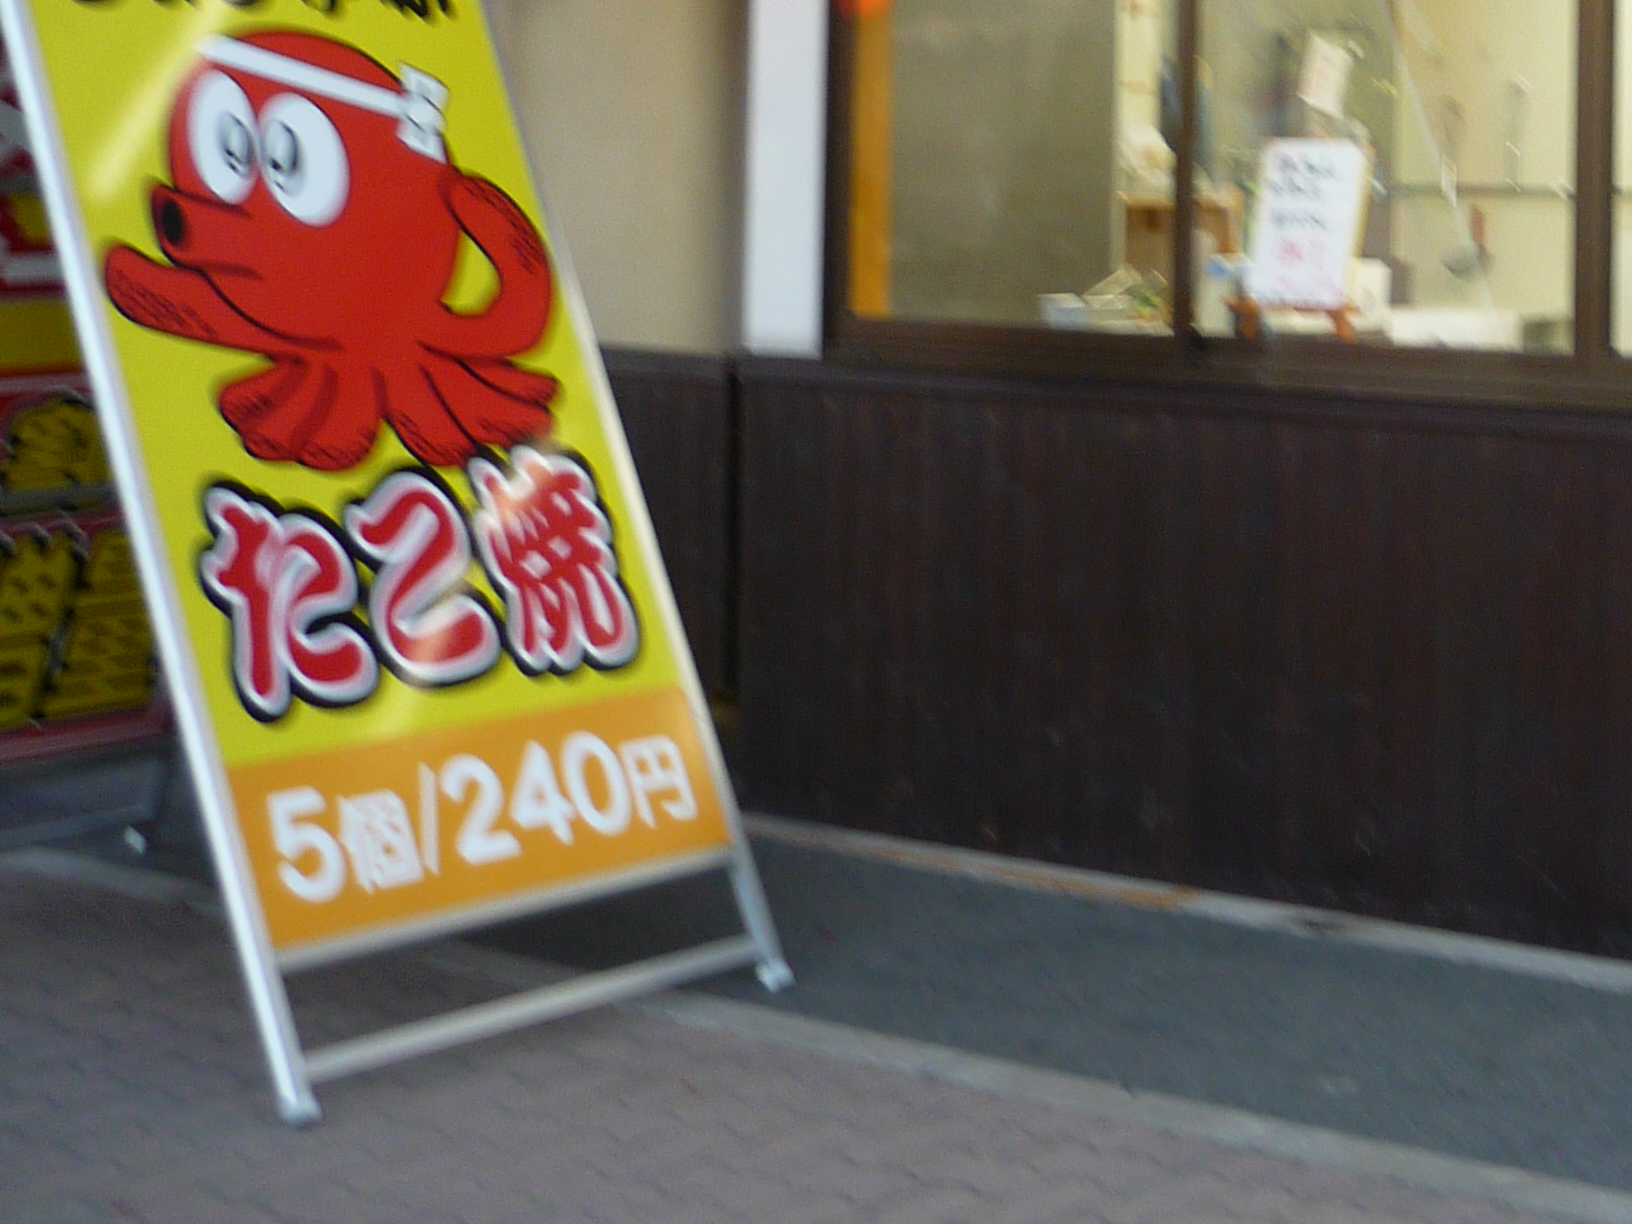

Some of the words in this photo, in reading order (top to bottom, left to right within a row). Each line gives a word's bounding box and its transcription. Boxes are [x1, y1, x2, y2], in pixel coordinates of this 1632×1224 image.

[199, 442, 641, 721] たこ焼
[266, 731, 697, 902] 5個/240円
